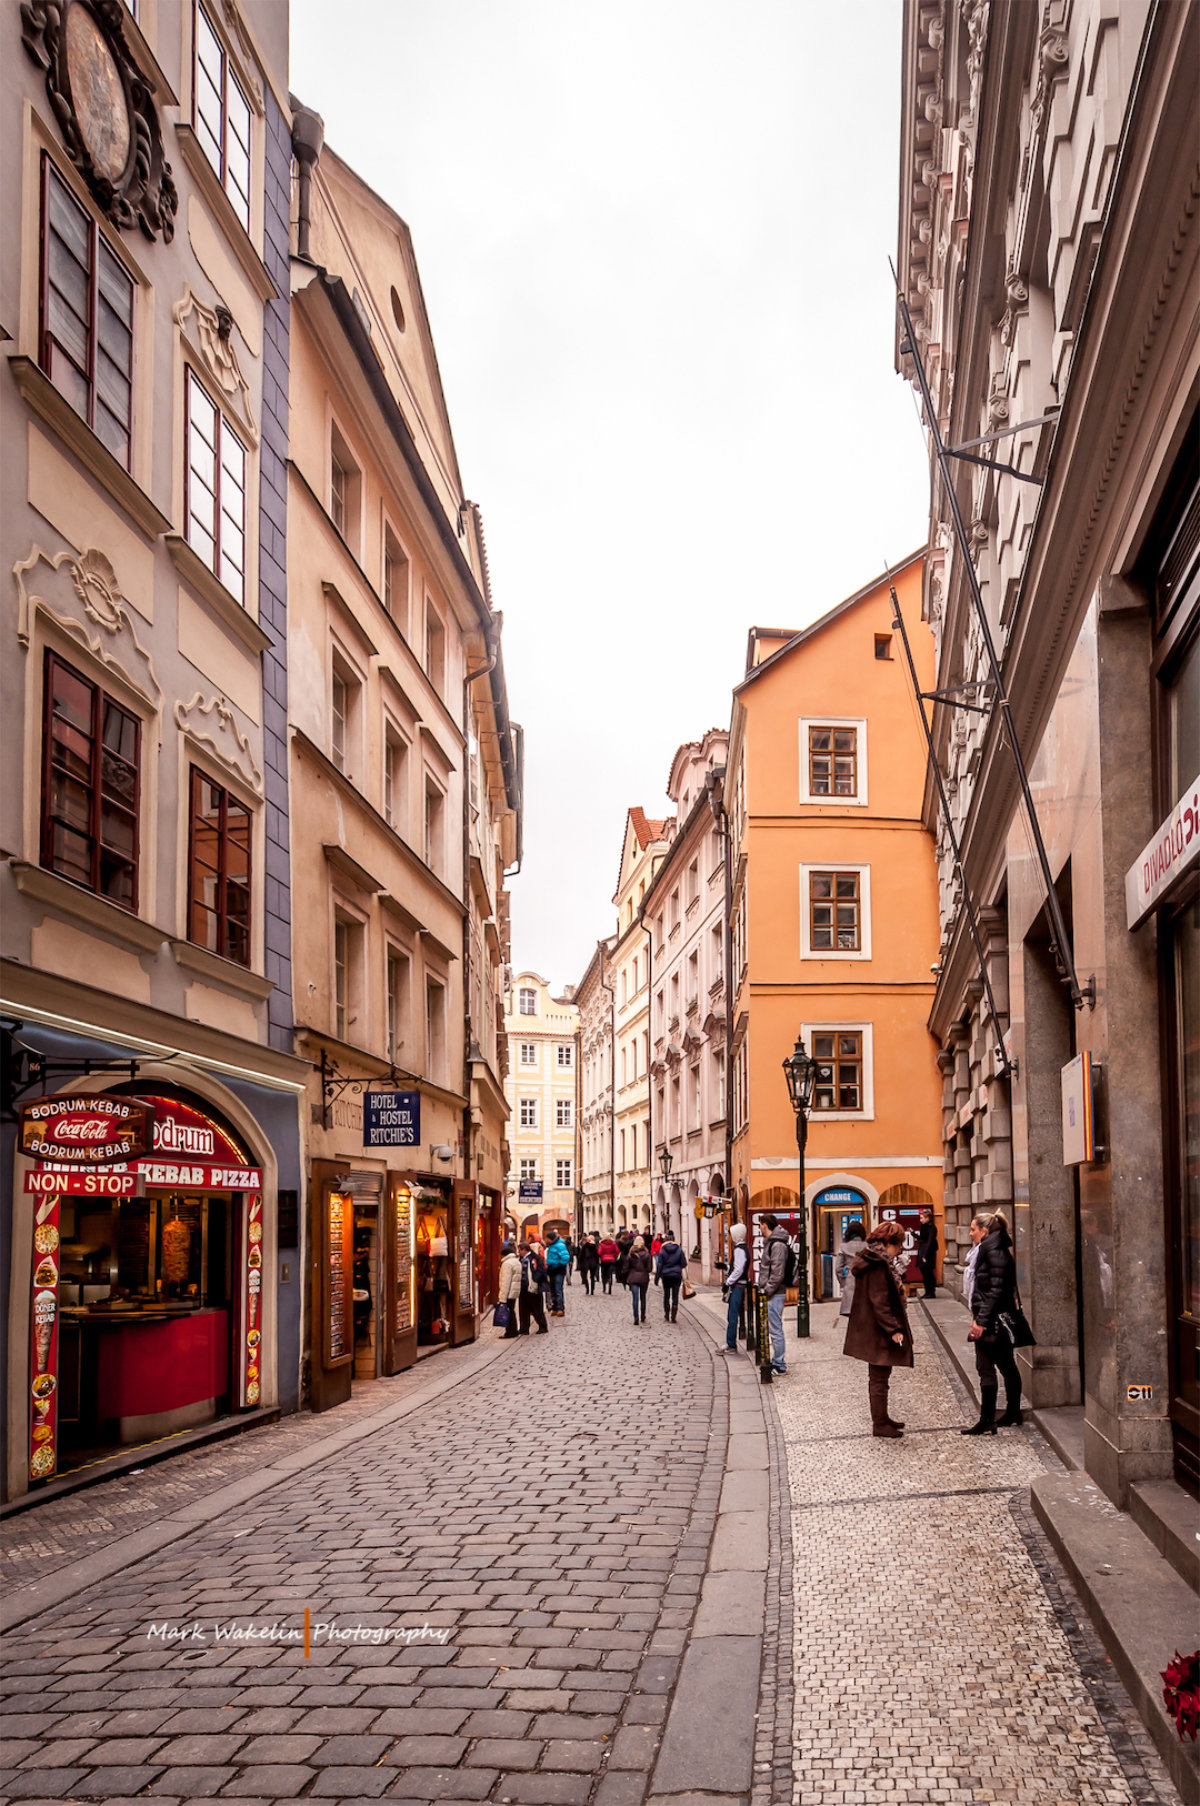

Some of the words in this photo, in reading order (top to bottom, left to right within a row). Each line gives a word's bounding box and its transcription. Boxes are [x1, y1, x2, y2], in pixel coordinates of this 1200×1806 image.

[1143, 819, 1184, 894] DIVADLO
[31, 1100, 86, 1119] BODRUM
[90, 1100, 130, 1118] KEBAB
[370, 1095, 398, 1109] HOTEL
[379, 1111, 413, 1126] HOSTEL
[53, 1119, 110, 1140] Coca-Cola
[370, 1127, 414, 1144] RITCHIE'S
[30, 1140, 86, 1159] BODRUM
[89, 1141, 131, 1159] KEBAB
[28, 1173, 68, 1192] NON
[84, 1175, 134, 1193] STOP
[137, 1163, 204, 1185] KEBAB
[210, 1168, 260, 1188] PIZZA
[824, 1193, 852, 1202] CHANGE
